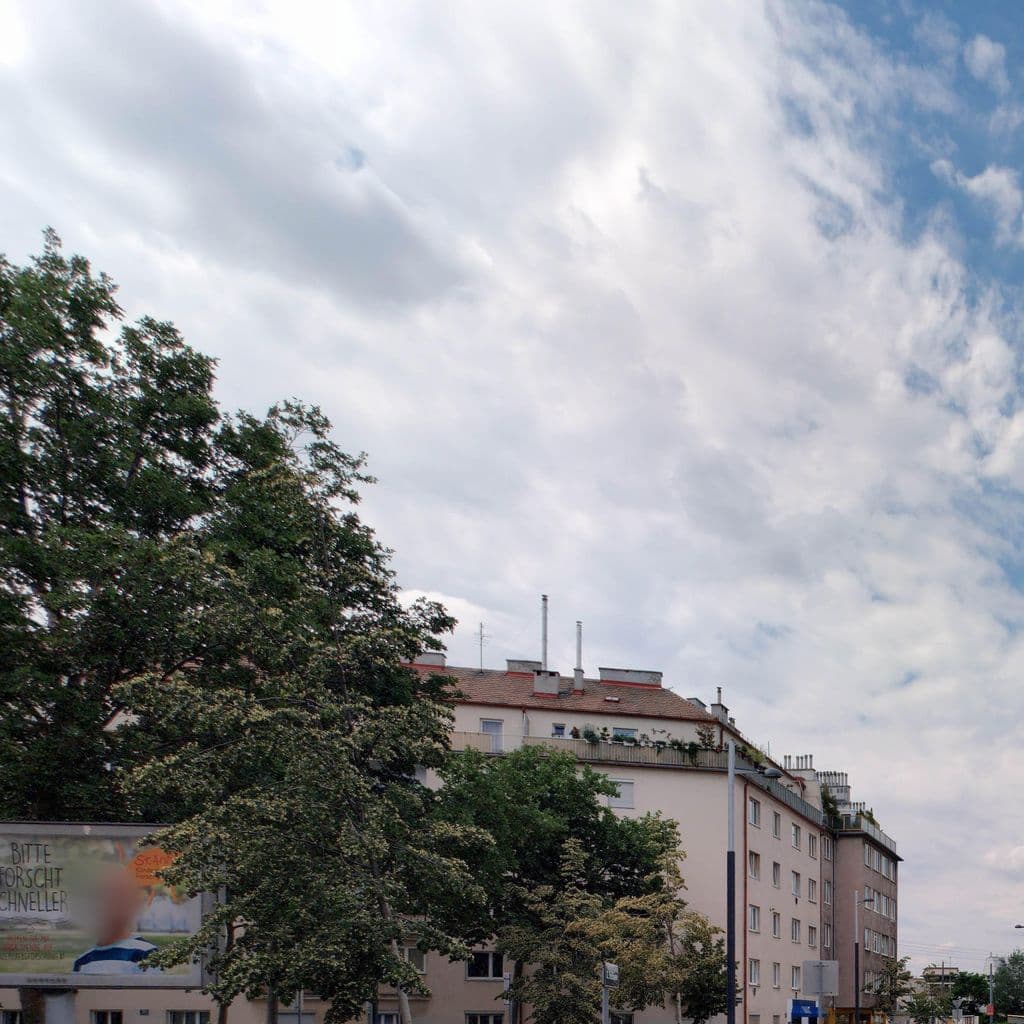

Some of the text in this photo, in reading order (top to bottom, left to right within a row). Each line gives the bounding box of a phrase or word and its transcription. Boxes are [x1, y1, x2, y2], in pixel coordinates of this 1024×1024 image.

[11, 842, 51, 865] BITTE
[0, 866, 64, 889] FORSCHT
[0, 890, 69, 913] CHNELLER
